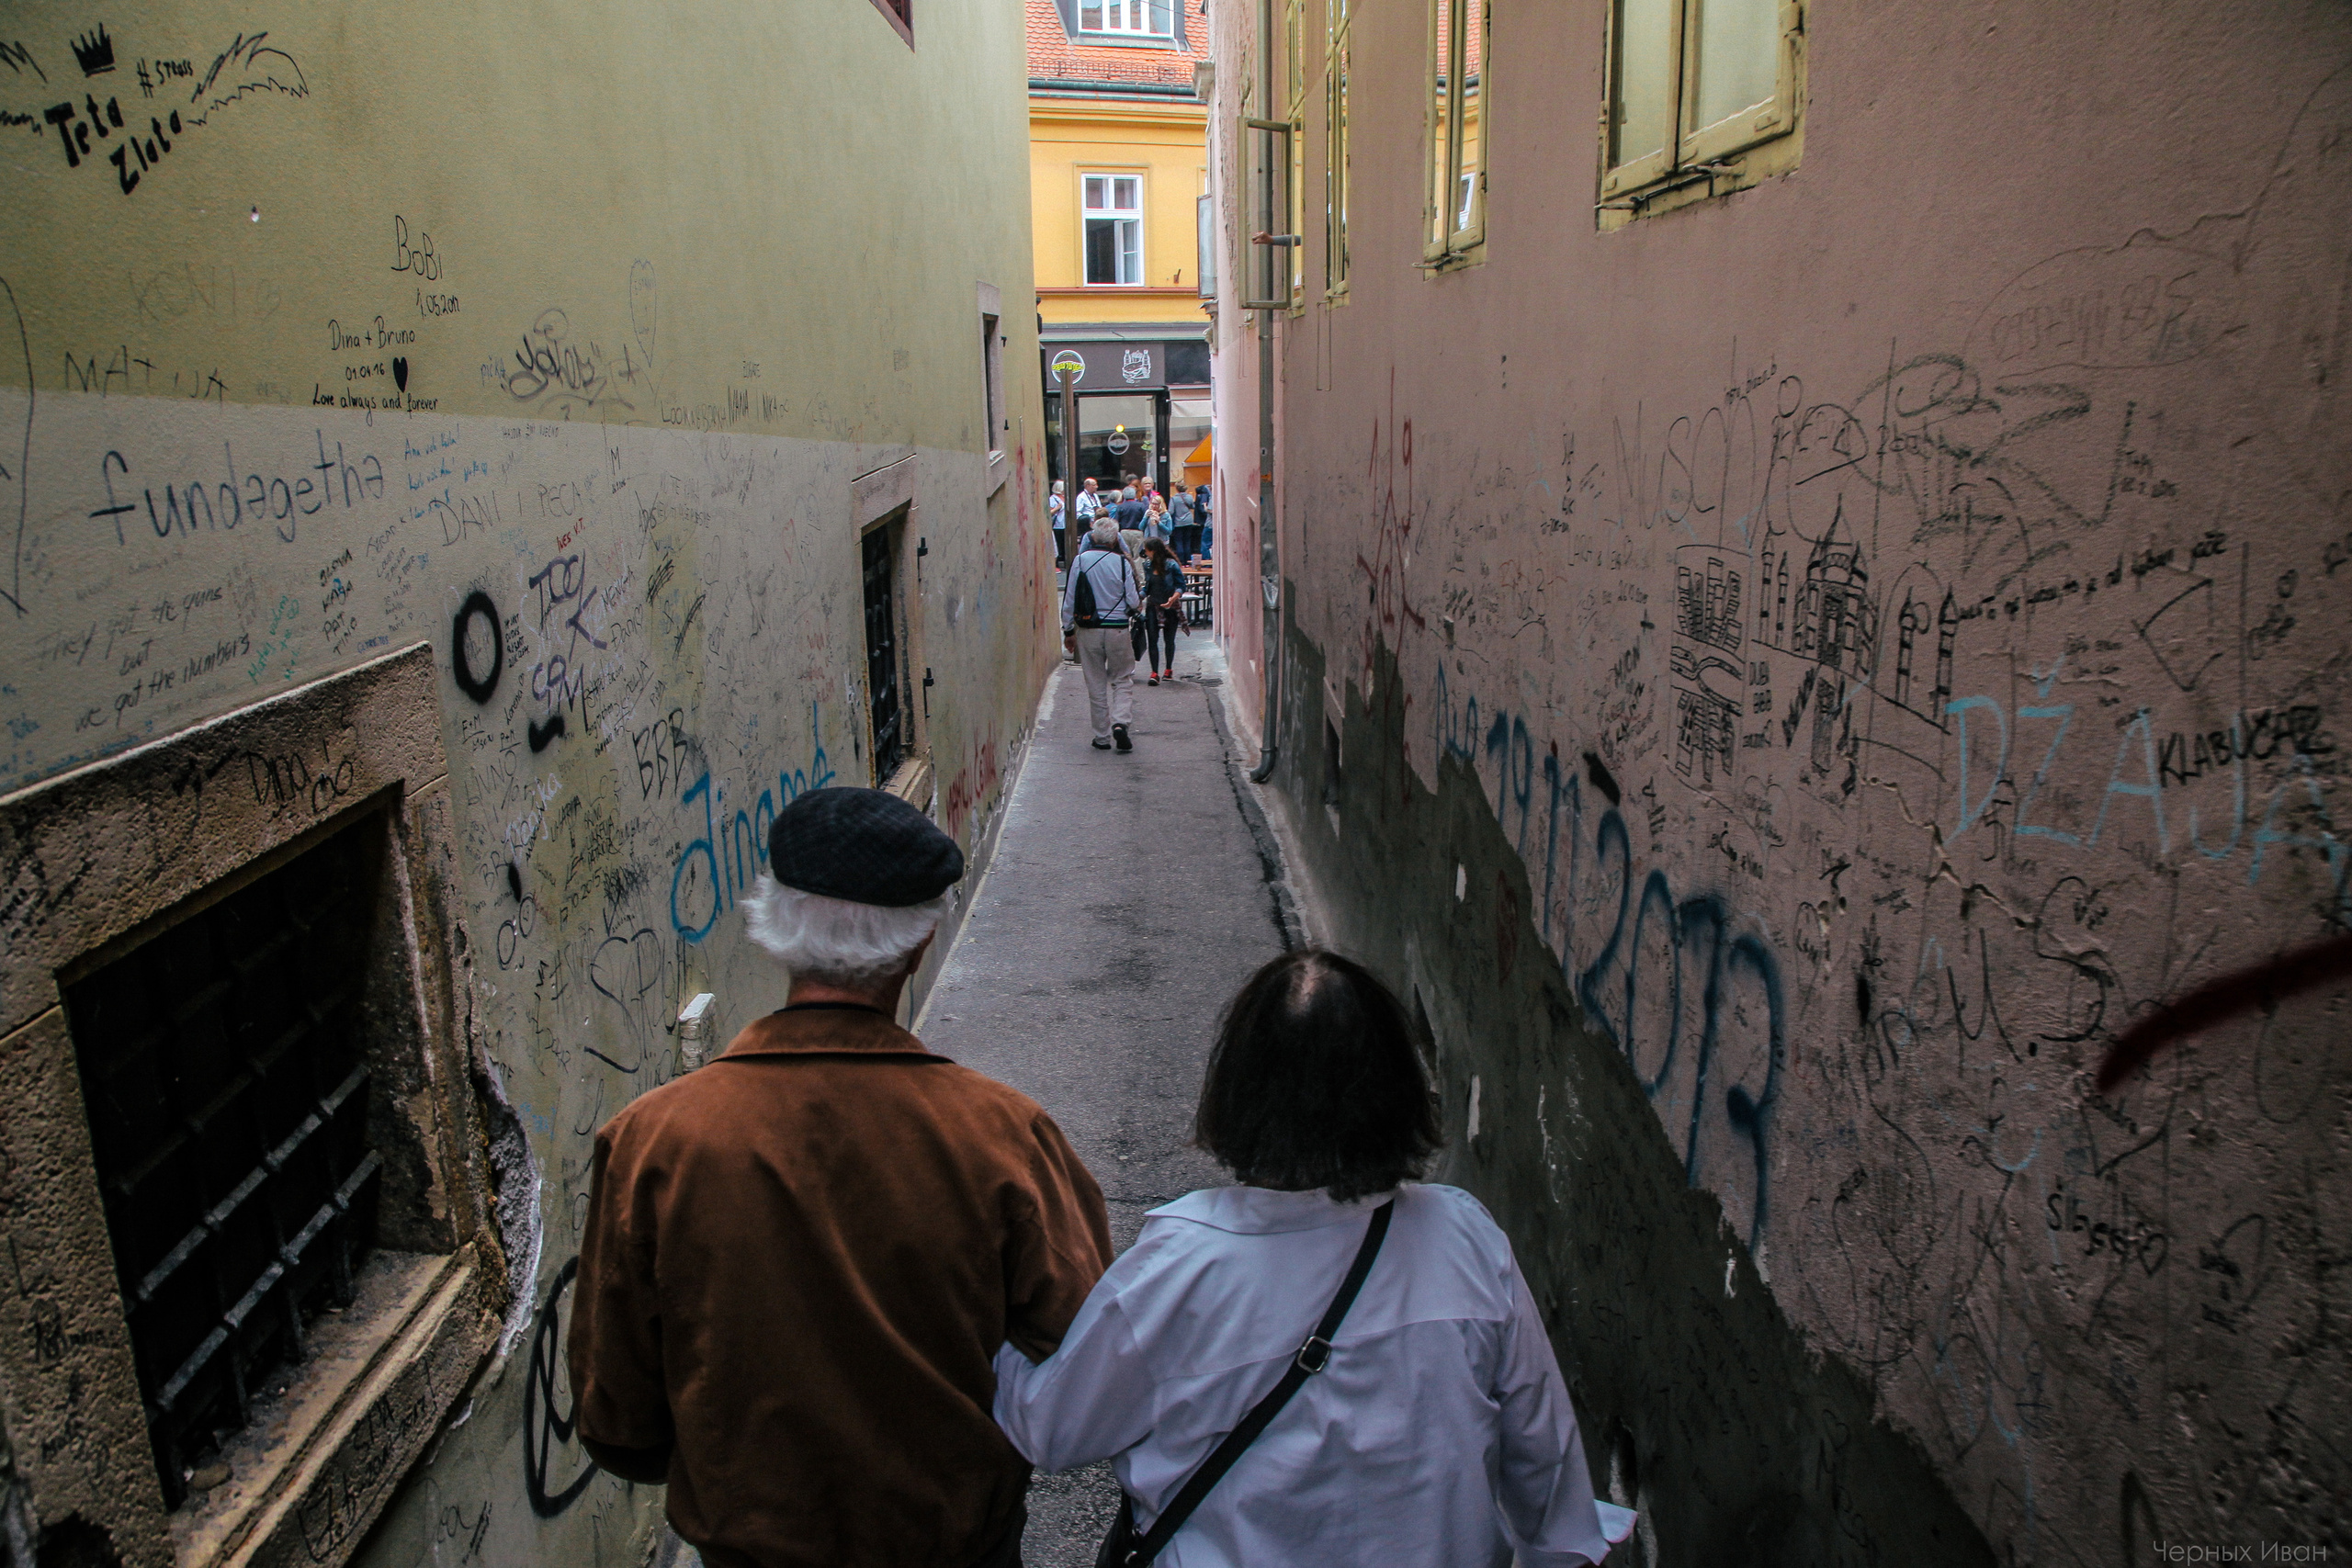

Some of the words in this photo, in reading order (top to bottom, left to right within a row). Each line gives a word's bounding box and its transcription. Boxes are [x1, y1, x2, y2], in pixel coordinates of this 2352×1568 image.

[328, 319, 361, 351] Dina
[374, 315, 415, 349] Bruno
[312, 383, 334, 406] Love
[340, 387, 377, 425] always
[382, 391, 401, 410] and
[407, 392, 438, 420] forever
[183, 633, 250, 684] numbers
